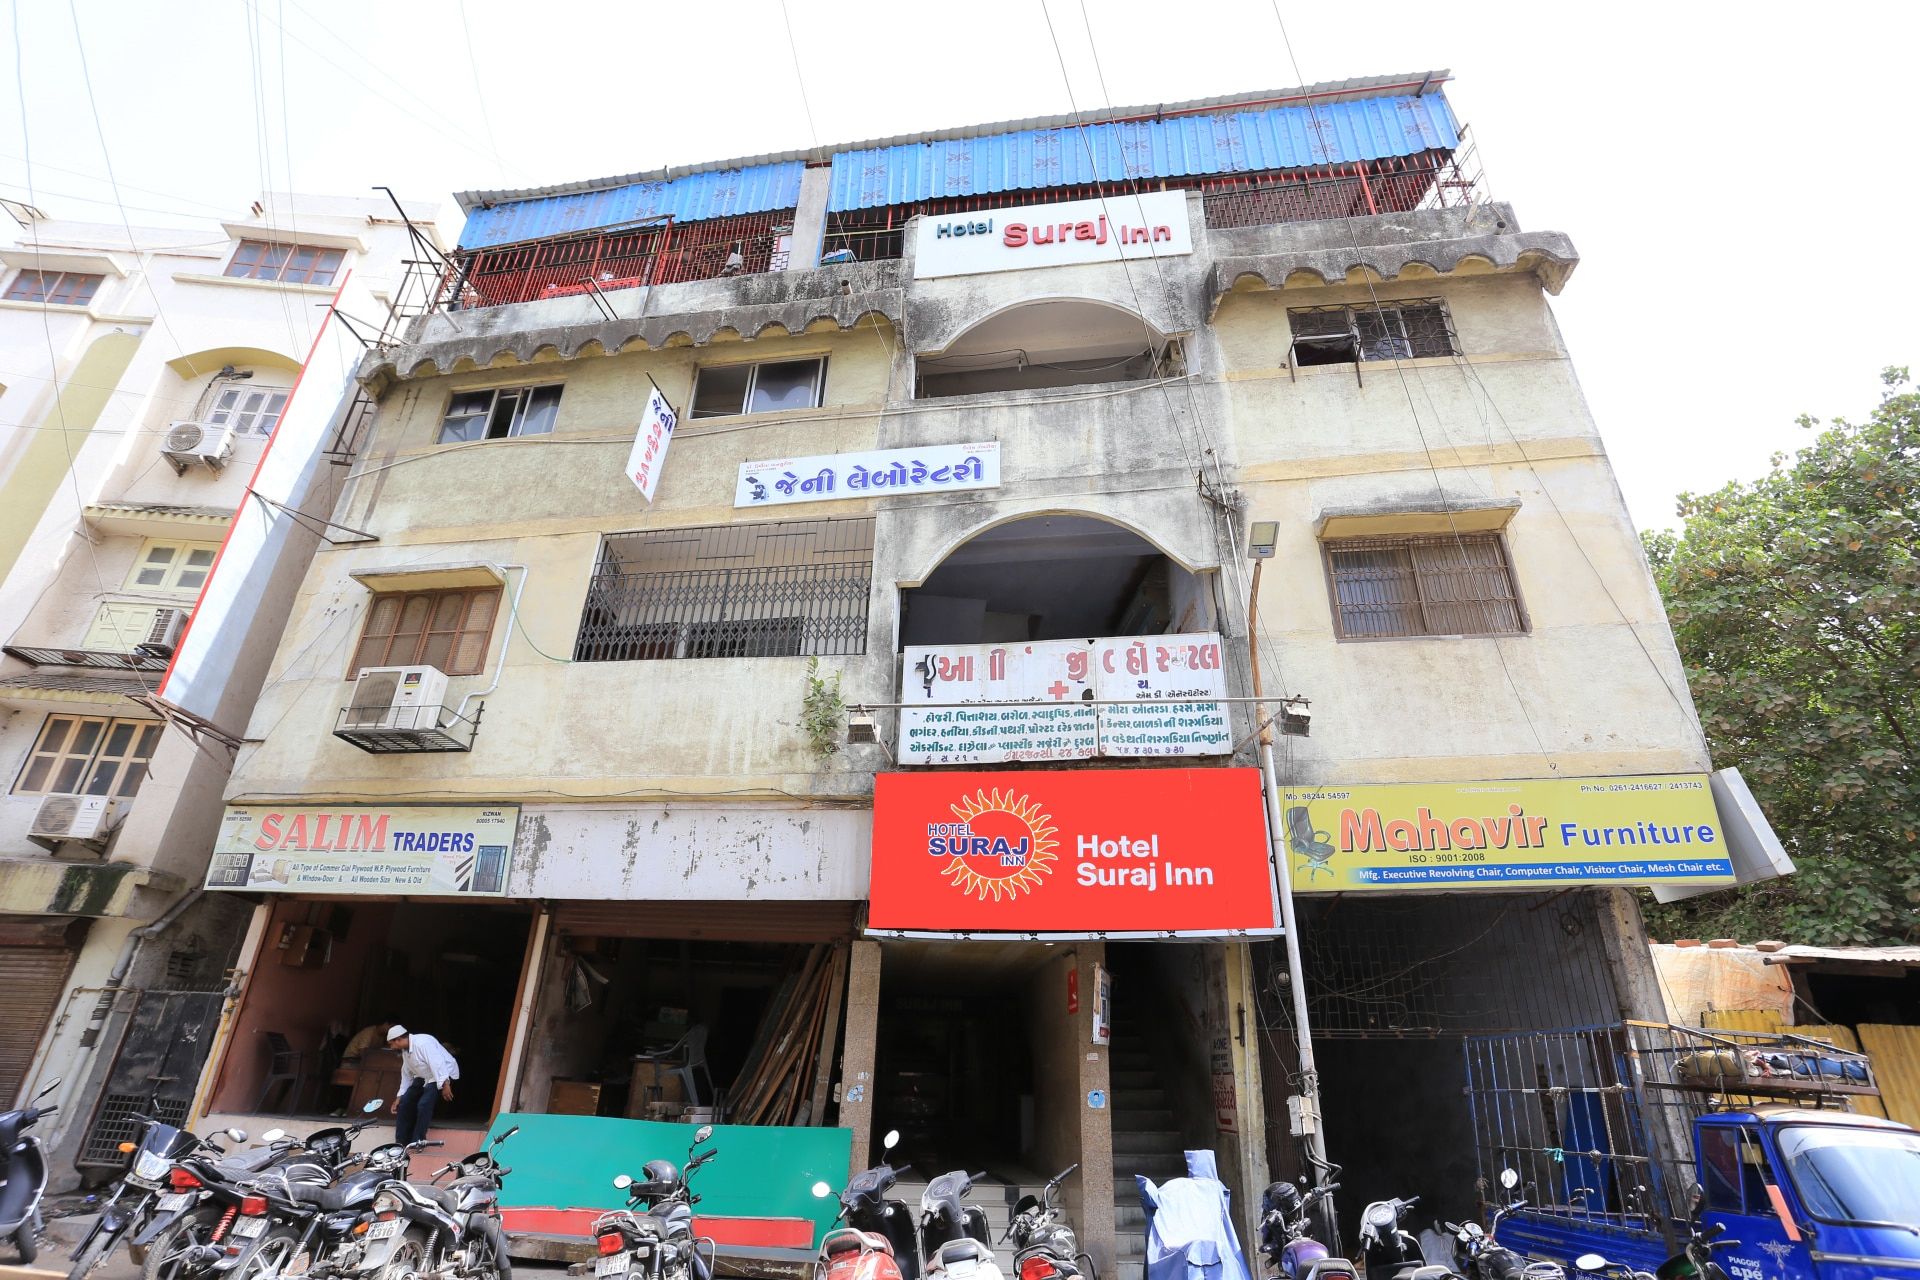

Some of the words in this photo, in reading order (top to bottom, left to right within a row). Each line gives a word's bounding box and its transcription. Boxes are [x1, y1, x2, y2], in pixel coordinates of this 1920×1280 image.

[937, 218, 993, 239] Hotel
[1003, 214, 1108, 248] Suraj
[1121, 224, 1172, 245] Inn
[775, 467, 836, 495] જેની
[846, 456, 982, 490] લેબોરેટરી
[1327, 792, 1350, 800] 54597
[254, 813, 391, 853] SALIM
[393, 832, 475, 852] TRADERS
[928, 823, 975, 837] HOTEL
[1340, 803, 1547, 853] Mahavir
[1560, 822, 1715, 846] Furniture
[928, 836, 1029, 857] SURAJ
[1077, 834, 1159, 858] Hotel
[1001, 855, 1026, 867] INN
[1409, 854, 1427, 863] ISO
[1435, 853, 1485, 862] 9001:2008
[300, 864, 312, 873] Type
[319, 864, 340, 872] Commer
[352, 864, 373, 874] Plywood
[385, 865, 407, 874] Plywood
[407, 865, 431, 873] Furniture
[1076, 862, 1157, 891] Suraj
[1165, 862, 1214, 886] Inn
[1359, 870, 1381, 881] Mfg.
[1383, 869, 1427, 880] Executive
[1429, 868, 1475, 879] Revolving
[1476, 866, 1504, 878] Chair,
[1505, 866, 1553, 878] Computer
[1555, 864, 1583, 877] Chair,
[1584, 864, 1616, 875] Visitor
[1617, 863, 1647, 875] Chair,
[1648, 863, 1675, 873] Mesh
[1677, 862, 1704, 872] Chair
[1705, 863, 1725, 871] etc.
[359, 875, 379, 883] Wooden
[395, 876, 406, 884] New
[1727, 1255, 1760, 1268] PIAGGIO
